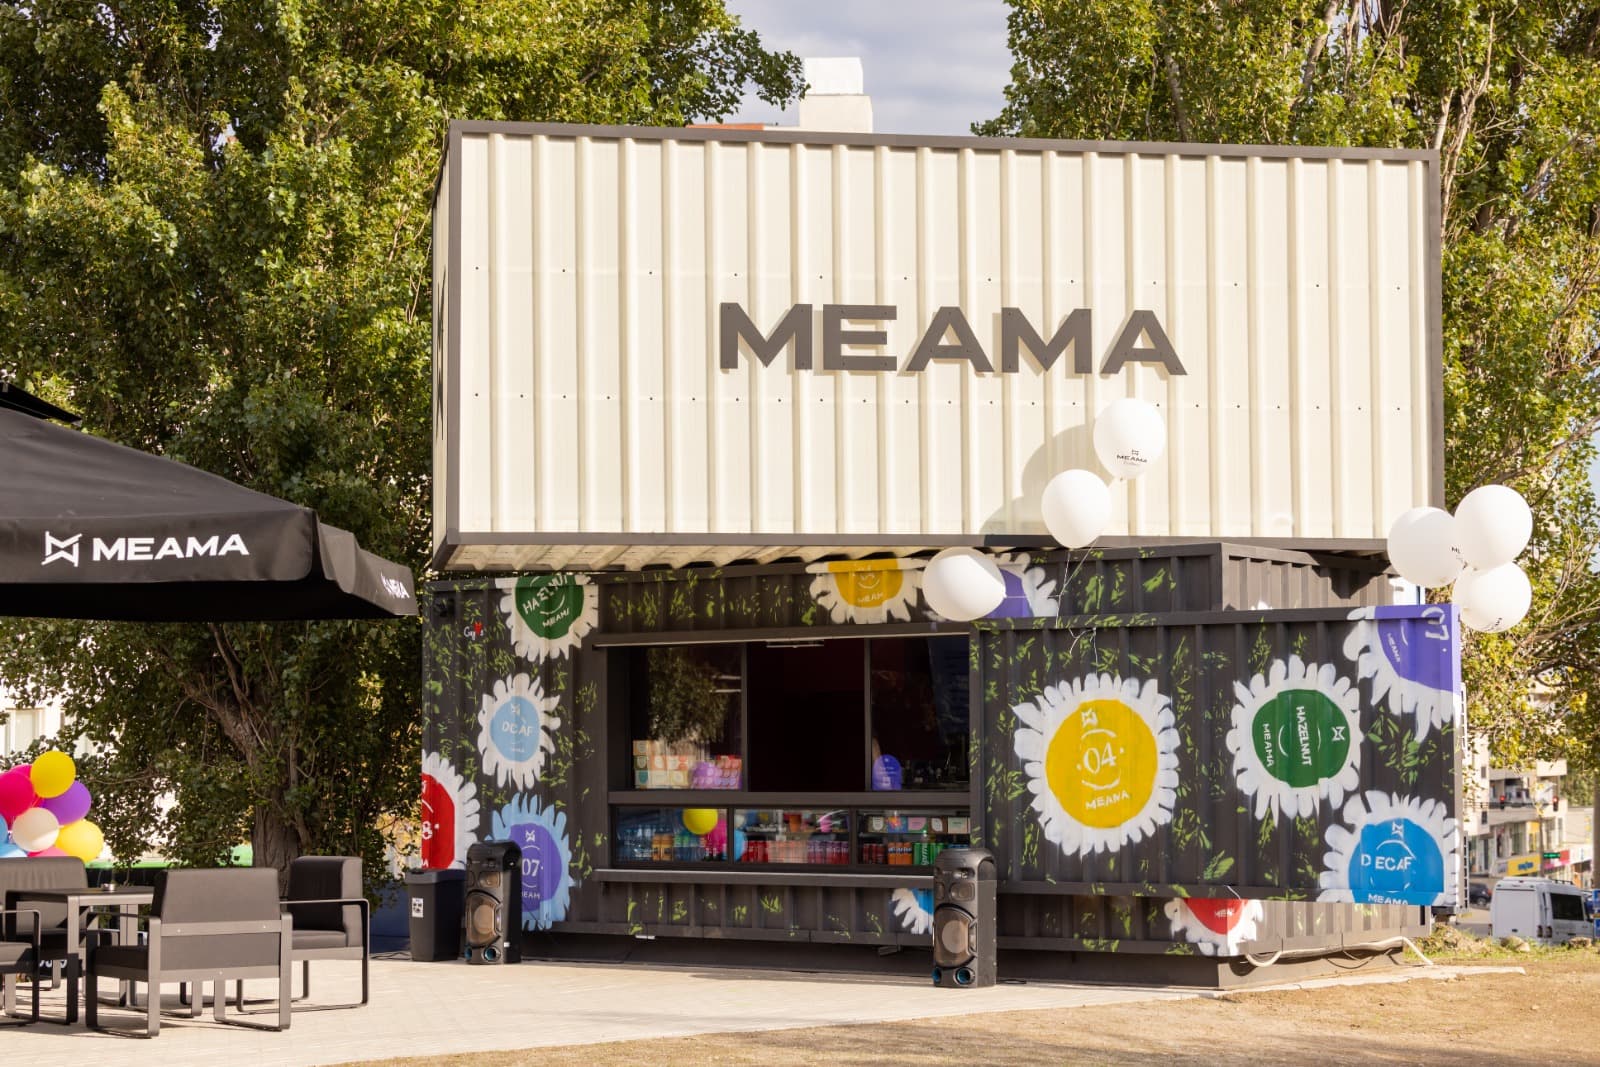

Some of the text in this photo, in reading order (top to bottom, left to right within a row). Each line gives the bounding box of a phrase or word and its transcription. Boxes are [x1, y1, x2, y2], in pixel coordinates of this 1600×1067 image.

[720, 302, 1188, 376] MEAMA
[93, 533, 250, 561] MEAMA
[1263, 723, 1274, 767] MEAMA
[1296, 706, 1312, 766] HAZELNUT
[1083, 742, 1117, 774] 04
[1361, 854, 1412, 871] DECAF
